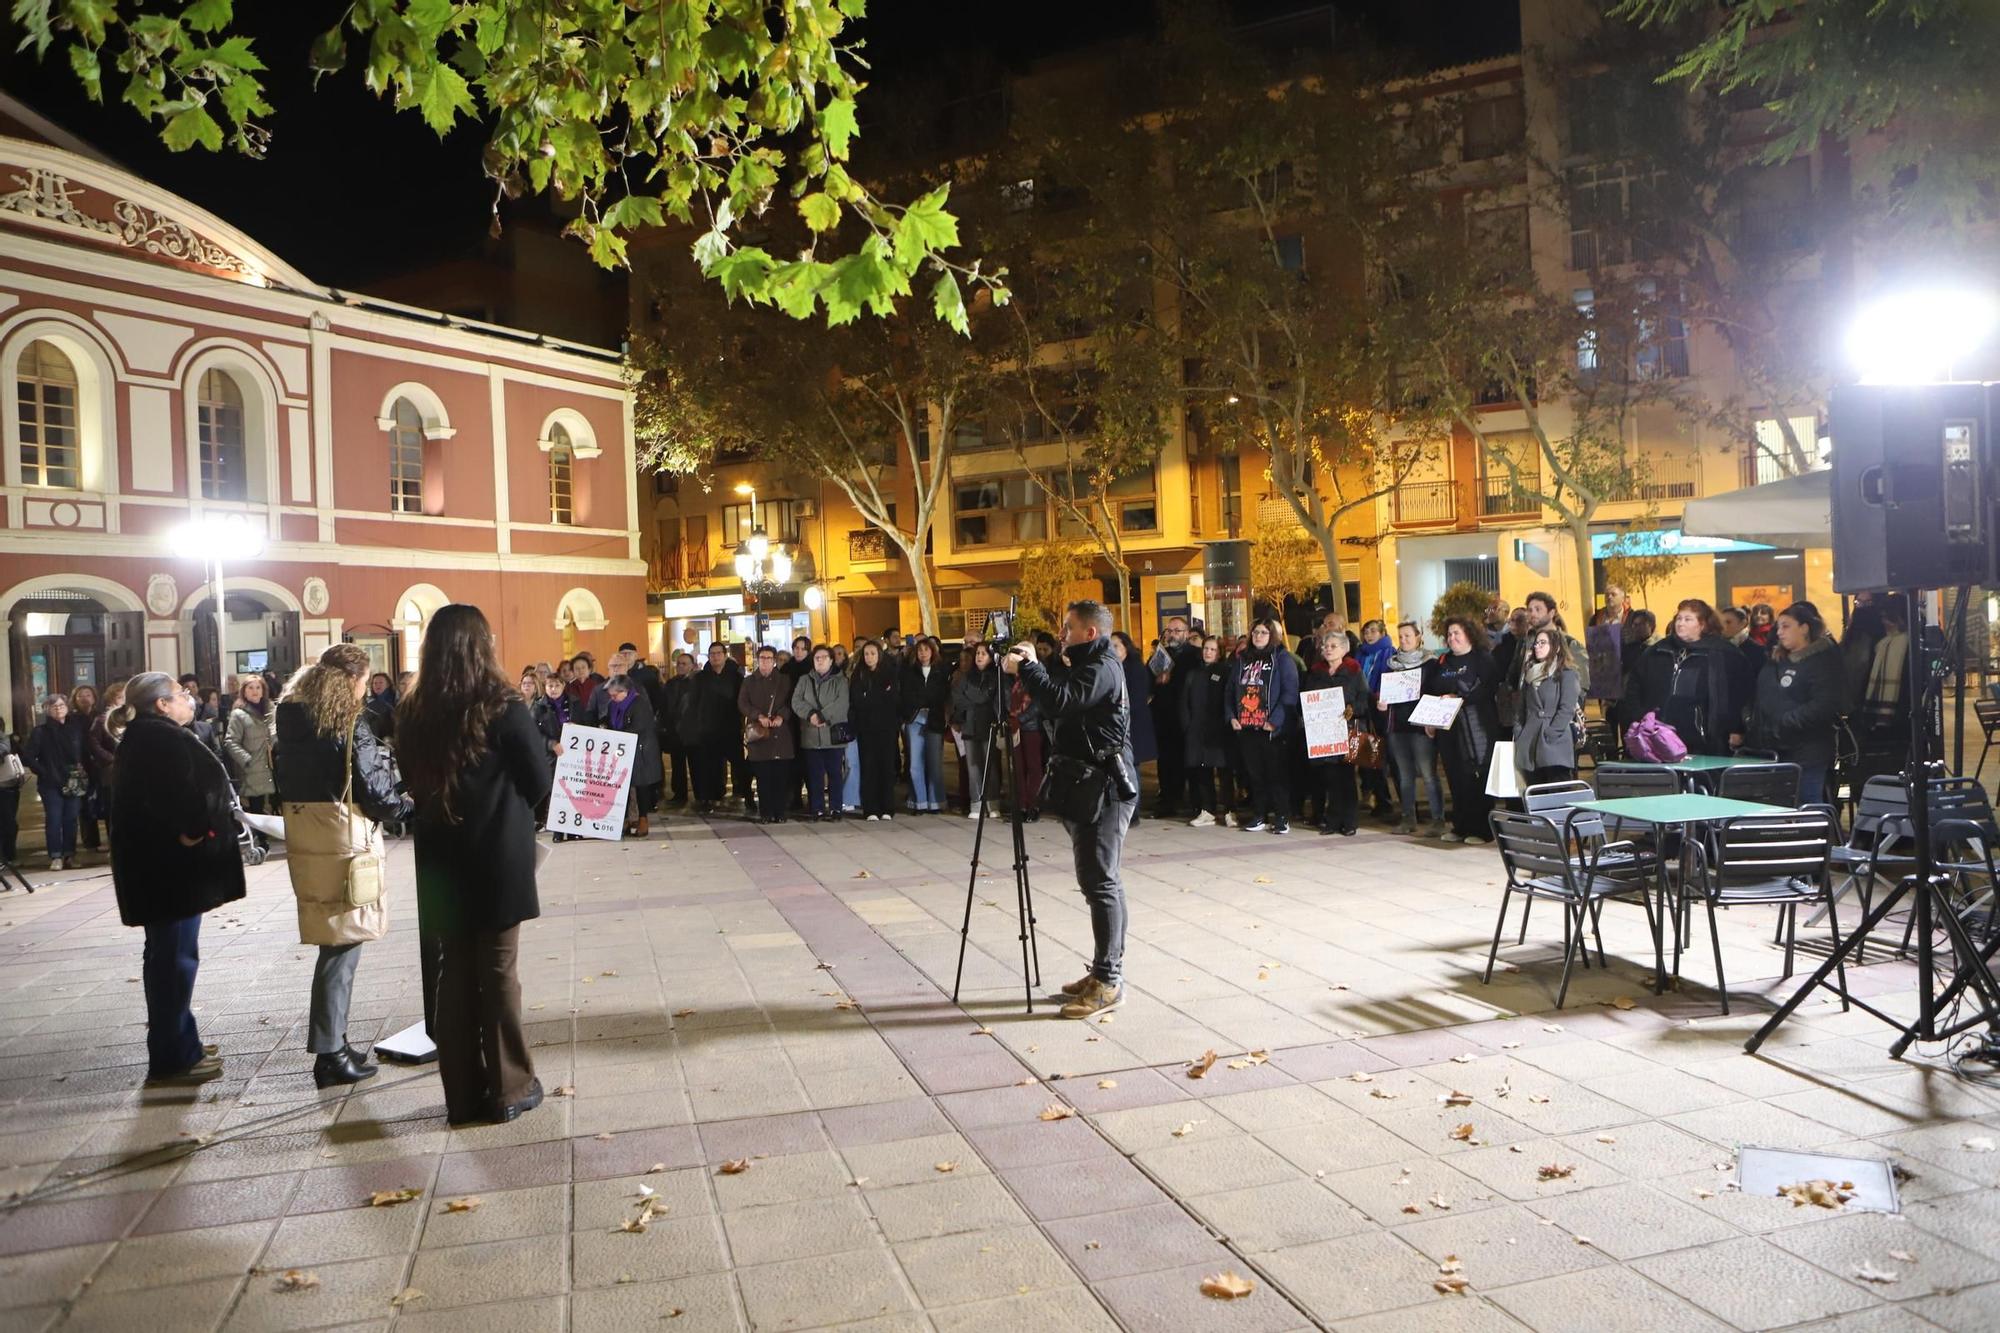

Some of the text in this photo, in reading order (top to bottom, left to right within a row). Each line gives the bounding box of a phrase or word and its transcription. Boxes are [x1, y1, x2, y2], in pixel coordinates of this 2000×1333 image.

[569, 736, 626, 756] 2025
[588, 779, 621, 788] VIOLENCIA
[557, 810, 583, 826] 38
